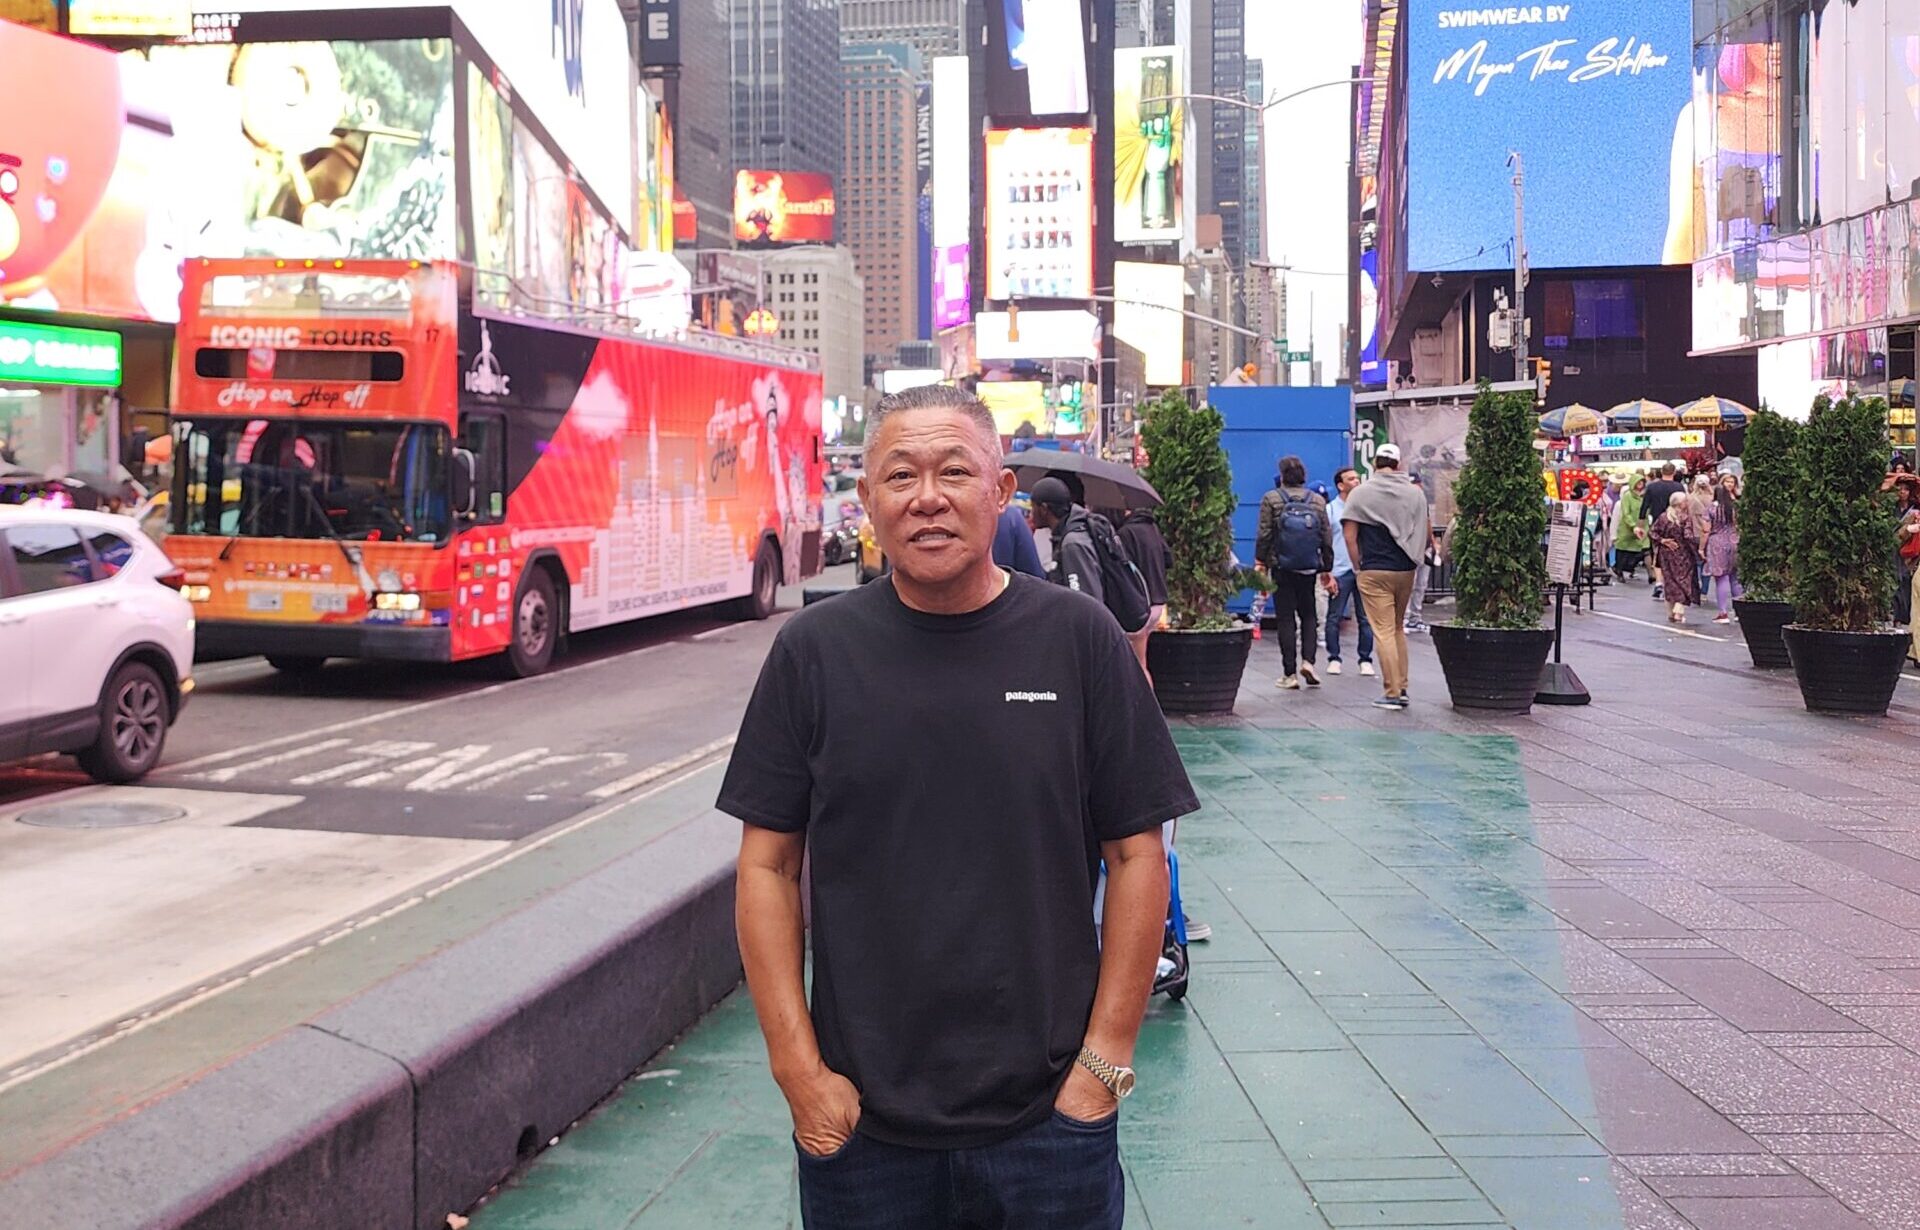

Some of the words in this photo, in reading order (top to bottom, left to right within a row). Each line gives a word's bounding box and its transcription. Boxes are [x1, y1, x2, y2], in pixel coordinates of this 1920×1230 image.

[1438, 7, 1542, 28] SWIMWEAR
[1547, 5, 1570, 21] BY
[1516, 38, 1578, 81] Thee
[1567, 36, 1668, 83] Stallion
[210, 325, 301, 347] ICONIC
[309, 330, 392, 347] TOURS
[426, 330, 440, 342] 17
[217, 382, 267, 409] Hop
[269, 388, 294, 405] on
[291, 385, 340, 408] Hop
[343, 384, 371, 408] off
[1005, 690, 1057, 702] patagonia
